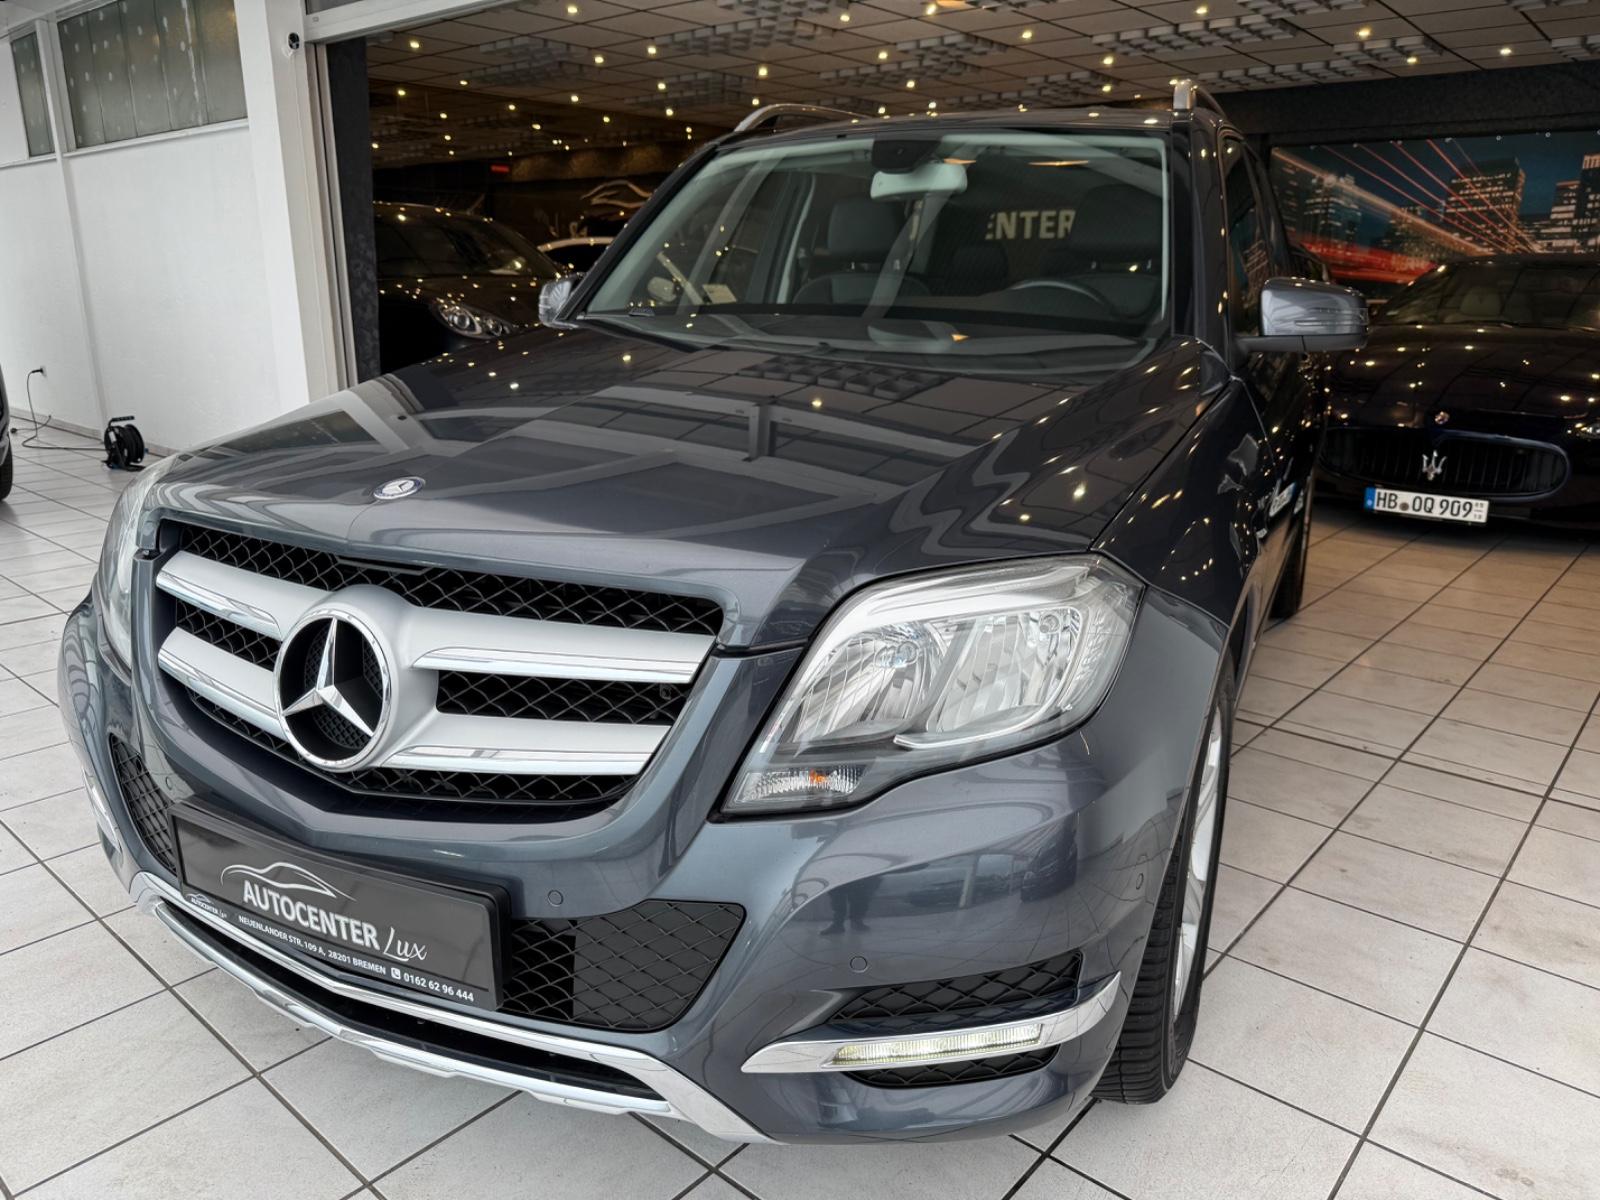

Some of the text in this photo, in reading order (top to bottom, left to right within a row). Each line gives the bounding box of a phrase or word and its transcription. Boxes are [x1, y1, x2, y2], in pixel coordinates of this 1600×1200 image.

[1376, 491, 1398, 509] HB
[1412, 495, 1435, 513] OQ
[1439, 499, 1473, 518] 909
[242, 880, 427, 961] AUTOCENTER Lux
[238, 915, 289, 941] NEUENLANDER
[288, 935, 304, 947] STR.
[303, 941, 318, 952] 109
[327, 950, 351, 963] 28201
[352, 957, 387, 975] BREMEN
[403, 972, 474, 1002] 0162 62 96 444
